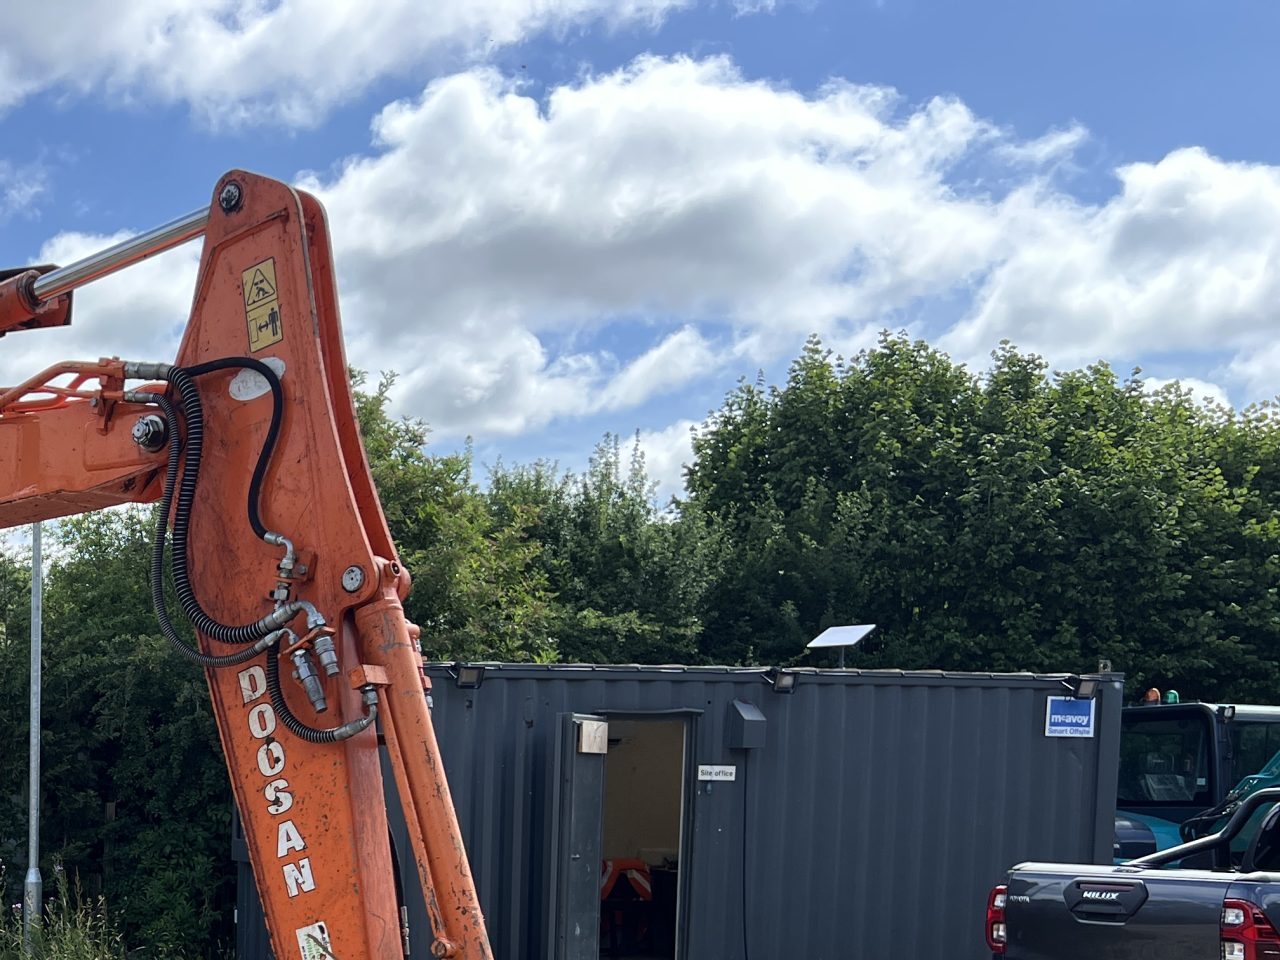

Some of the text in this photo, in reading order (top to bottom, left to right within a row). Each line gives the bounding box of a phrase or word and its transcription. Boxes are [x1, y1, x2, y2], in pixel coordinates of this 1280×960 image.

[700, 769, 733, 777] Site office
[237, 664, 316, 899] DOOSAN
[1083, 890, 1119, 900] HILUX
